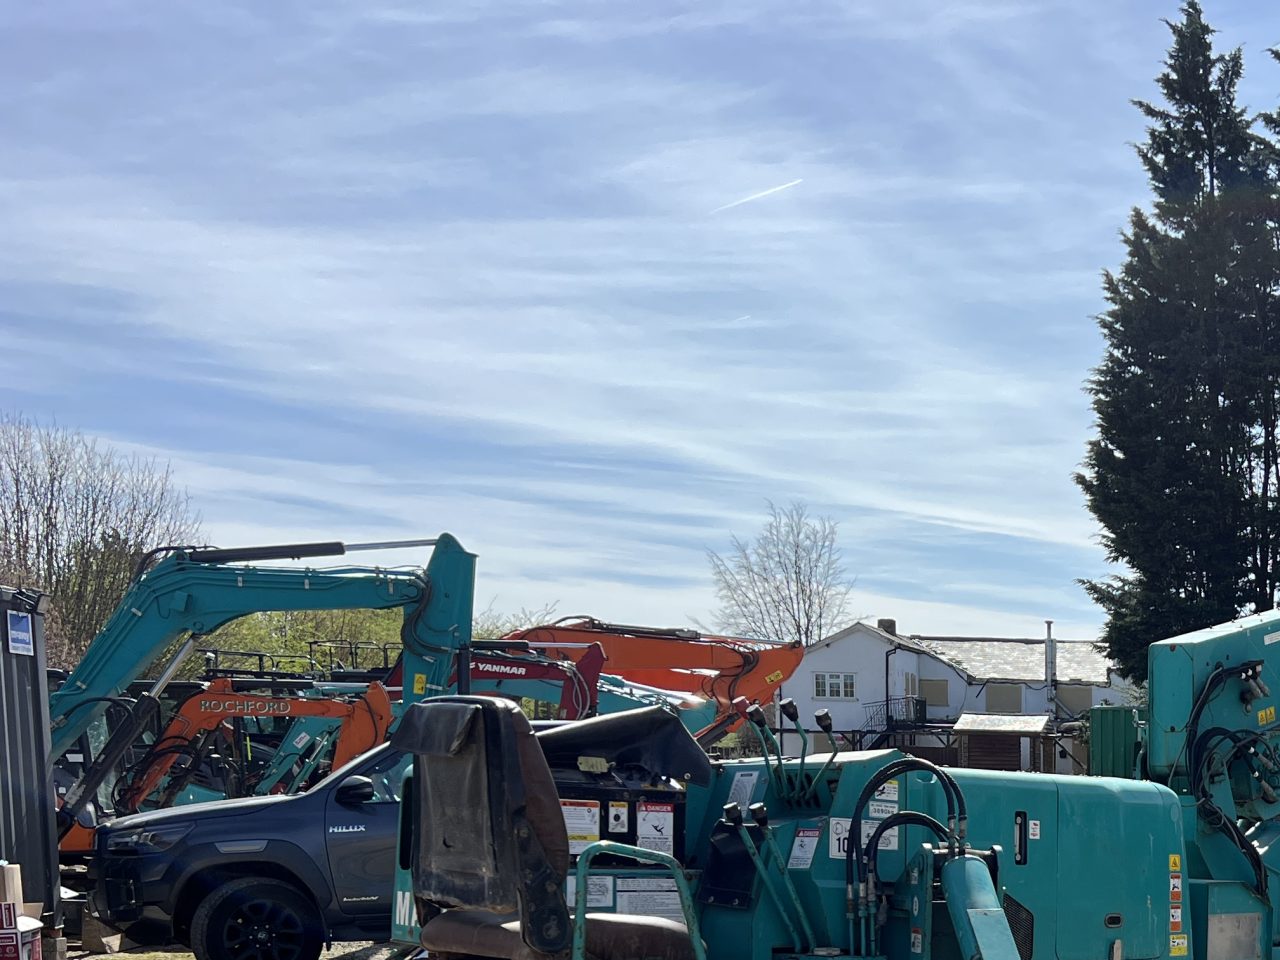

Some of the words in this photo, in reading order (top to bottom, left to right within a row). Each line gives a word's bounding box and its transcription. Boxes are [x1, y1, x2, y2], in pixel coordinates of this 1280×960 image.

[477, 663, 526, 675] YANMAR
[201, 700, 291, 714] ROCHFORD
[329, 825, 366, 833] HILUX
